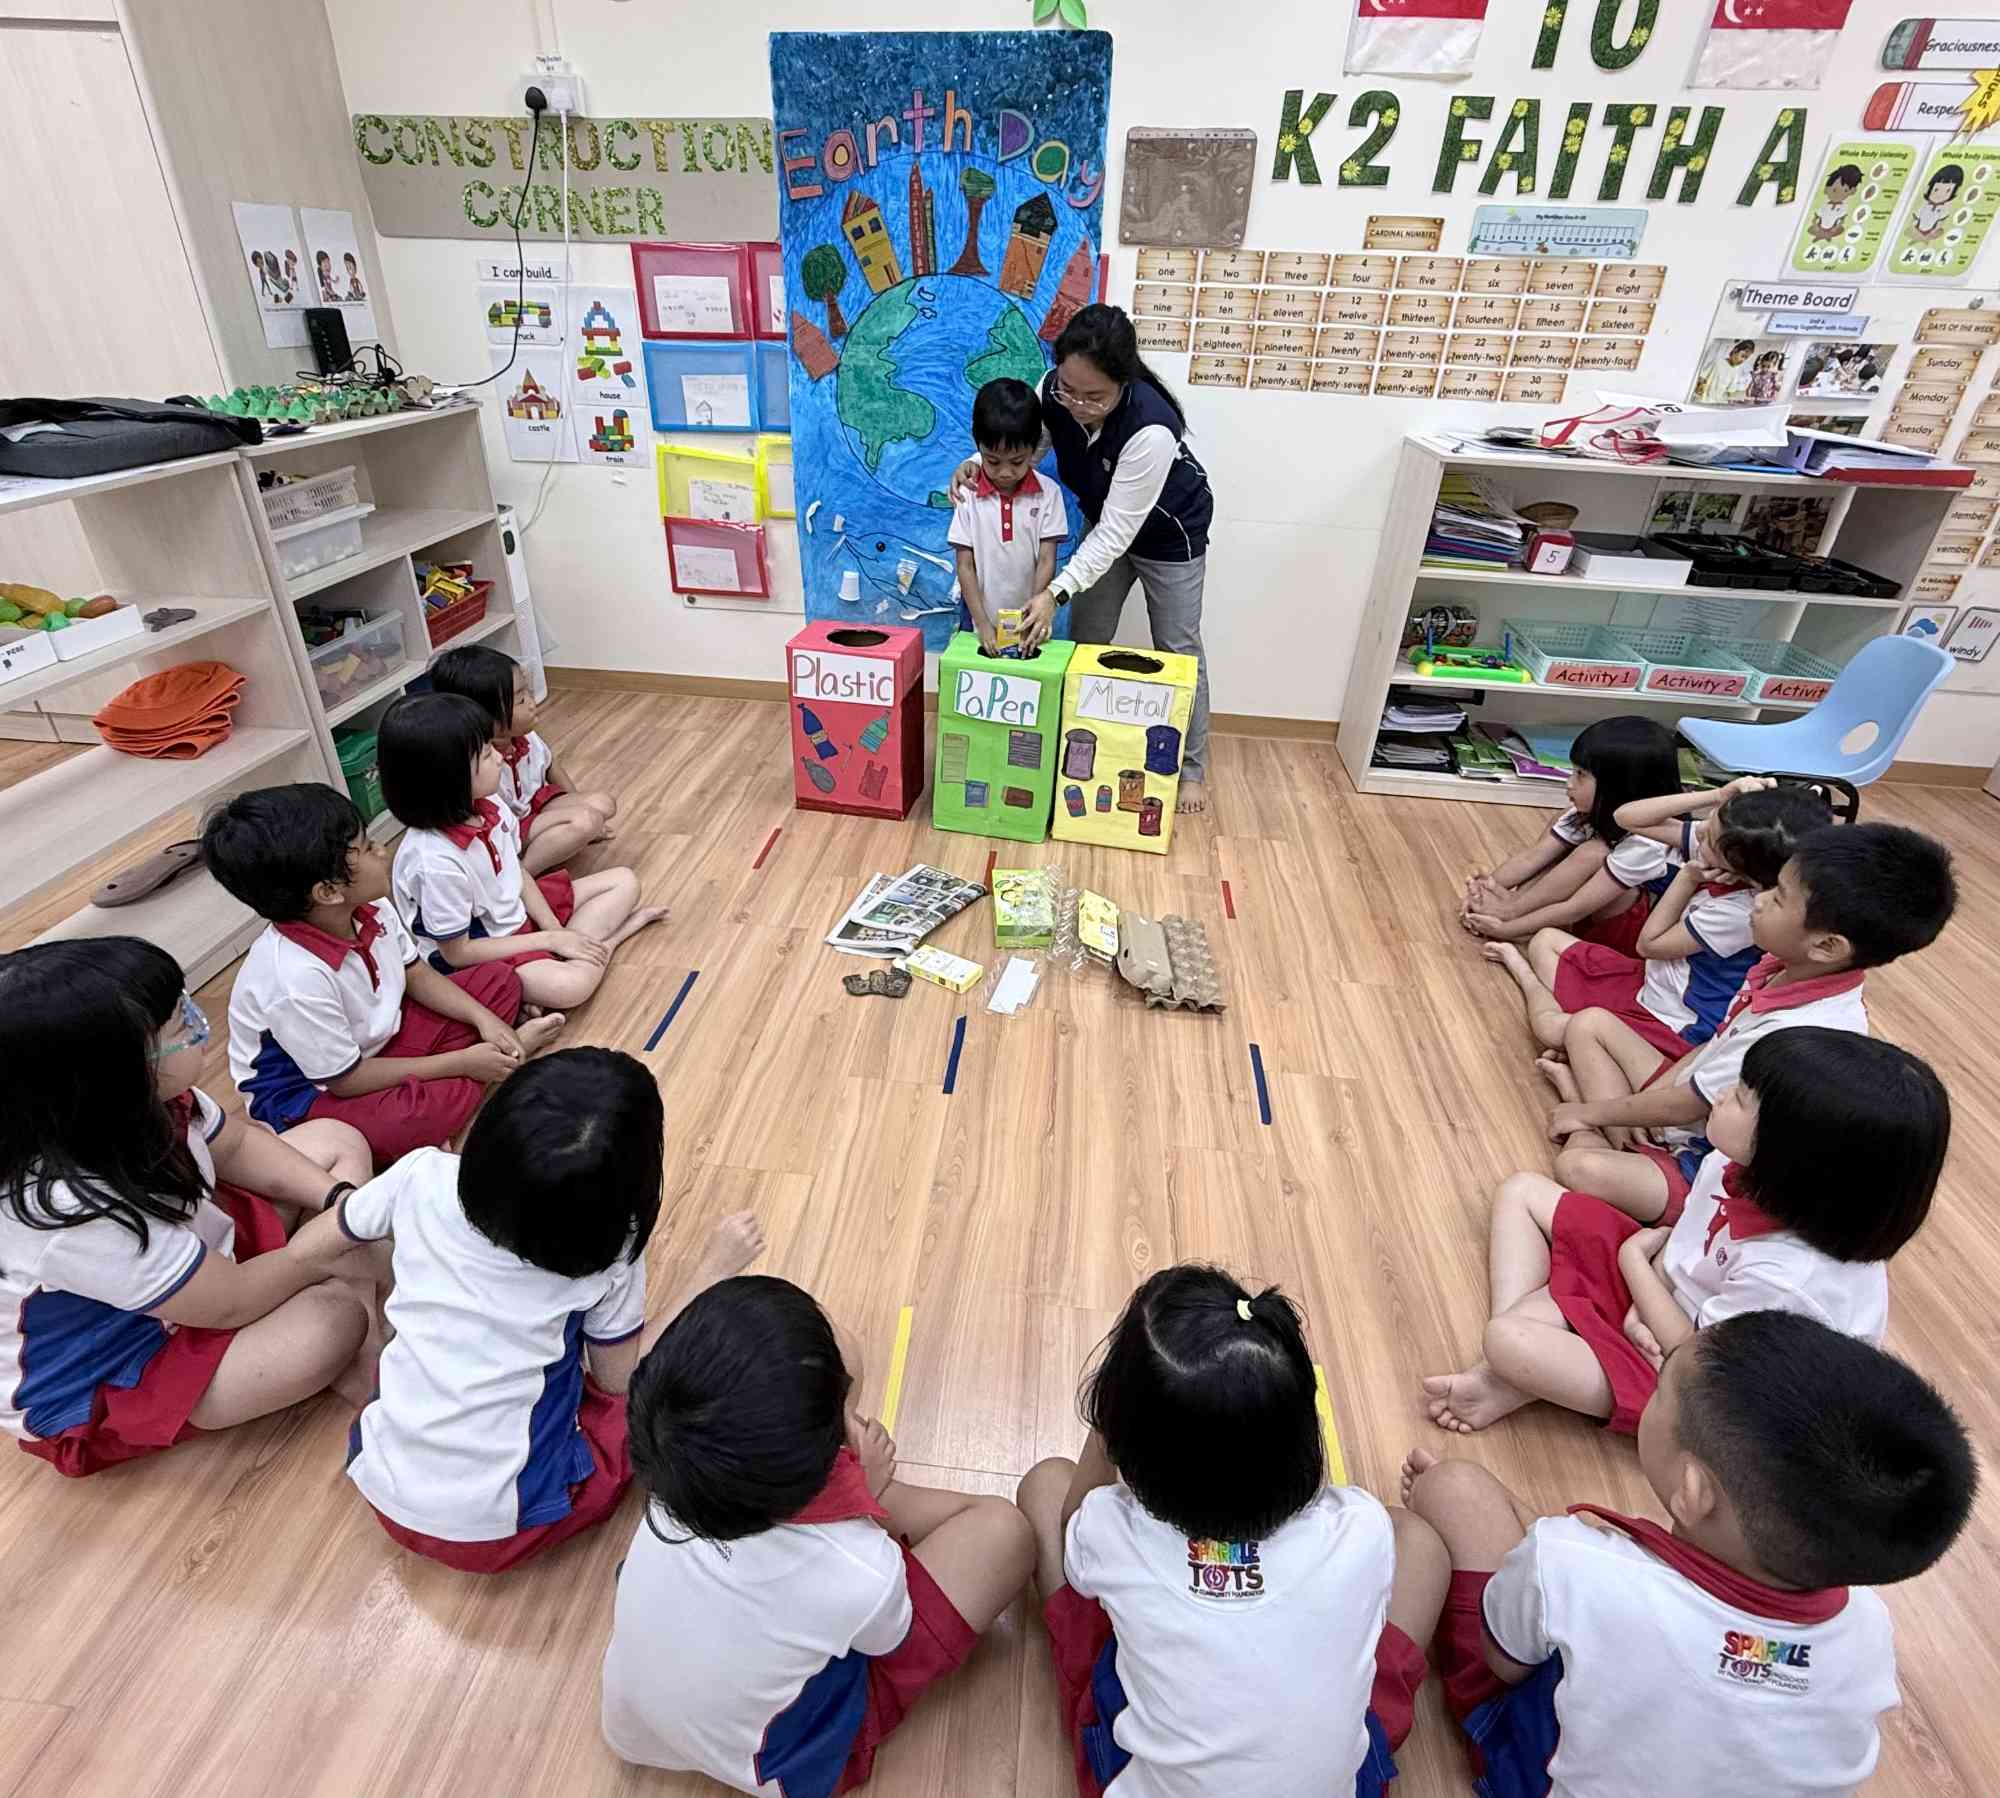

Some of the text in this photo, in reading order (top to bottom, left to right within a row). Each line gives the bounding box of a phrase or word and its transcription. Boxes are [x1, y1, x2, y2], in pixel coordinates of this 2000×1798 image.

[1917, 102, 1961, 118] Respec
[354, 114, 773, 173] CONSTRUCTION
[780, 88, 1105, 208] Earth Day
[1272, 89, 1808, 206] K2 FAITH A
[463, 180, 667, 235] CORNER
[1369, 228, 1404, 238] CARDINAL
[1230, 254, 1237, 263] 2
[1295, 256, 1302, 265] 3
[1361, 258, 1368, 267] 4
[1428, 261, 1435, 270] 5
[1494, 264, 1501, 272] 6
[1561, 266, 1567, 274] 7
[492, 266, 499, 277] I
[503, 269, 521, 278] can
[1158, 268, 1175, 276] one
[1223, 269, 1239, 278] two
[1284, 271, 1308, 280] three
[1629, 269, 1636, 278] 8
[1352, 272, 1370, 282] four
[1419, 276, 1436, 286] five
[1488, 280, 1500, 288] six
[1545, 282, 1574, 290] seven
[1616, 284, 1640, 294] eight
[1224, 291, 1234, 299] 10
[1286, 294, 1295, 302] 11
[1744, 290, 1852, 308] Theme Board
[1351, 296, 1362, 305] 12
[1417, 299, 1427, 308] 13
[1484, 300, 1494, 309] 14
[1153, 303, 1172, 312] nine
[1219, 305, 1233, 314] ten
[1550, 303, 1560, 312] 15
[1617, 305, 1628, 314] 16
[1273, 309, 1303, 318] eleven
[1338, 311, 1368, 320] twelve
[1401, 313, 1435, 323] thirteen
[1465, 315, 1504, 324] fourteen
[1536, 317, 1565, 327] fifteen
[1157, 323, 1167, 331] 17
[1601, 320, 1634, 329] sixteen
[1220, 326, 1230, 335] 18
[1282, 329, 1292, 337] 19
[517, 333, 535, 341] ruck
[1343, 332, 1355, 341] 20
[1409, 336, 1419, 344] 21
[1137, 338, 1183, 346] seventeen
[1203, 340, 1242, 350] eighteen
[1474, 338, 1487, 347] 22
[1539, 340, 1551, 349] 23
[1605, 342, 1616, 350] 24
[1264, 344, 1303, 353] nineteen
[1331, 346, 1361, 356] twenty
[1386, 350, 1436, 360] twenty-one
[1451, 352, 1502, 363] twenty-two
[1215, 360, 1224, 368] 25
[1512, 355, 1570, 365] twenty-three
[1581, 356, 1633, 366] twenty-four
[1926, 358, 1962, 369] Sunday
[1277, 363, 1287, 371] 26
[1338, 367, 1349, 375] 27
[1194, 372, 1241, 383] twenty-five
[1258, 376, 1301, 387] twenty-six
[1466, 373, 1477, 382] 29
[1530, 376, 1541, 384] 30
[1312, 379, 1369, 390] twenty-seven
[1377, 383, 1434, 394] twenty-eight
[600, 391, 621, 400] house
[1442, 386, 1494, 397] twenty-nine
[1909, 393, 1949, 404] Monday
[528, 424, 550, 432] castle
[1897, 424, 1934, 434] Tuesday
[606, 455, 624, 464] train
[1546, 551, 1560, 563] 5
[1949, 645, 1981, 656] windy
[793, 654, 893, 701] Plastic
[1555, 669, 1631, 684] Activity 1
[1656, 675, 1736, 692] Activity 2
[1769, 683, 1827, 697] Activit
[1082, 679, 1170, 721] Metal
[1188, 1537, 1261, 1564] SPARKLE
[1723, 1631, 1811, 1667] SPARKLE
